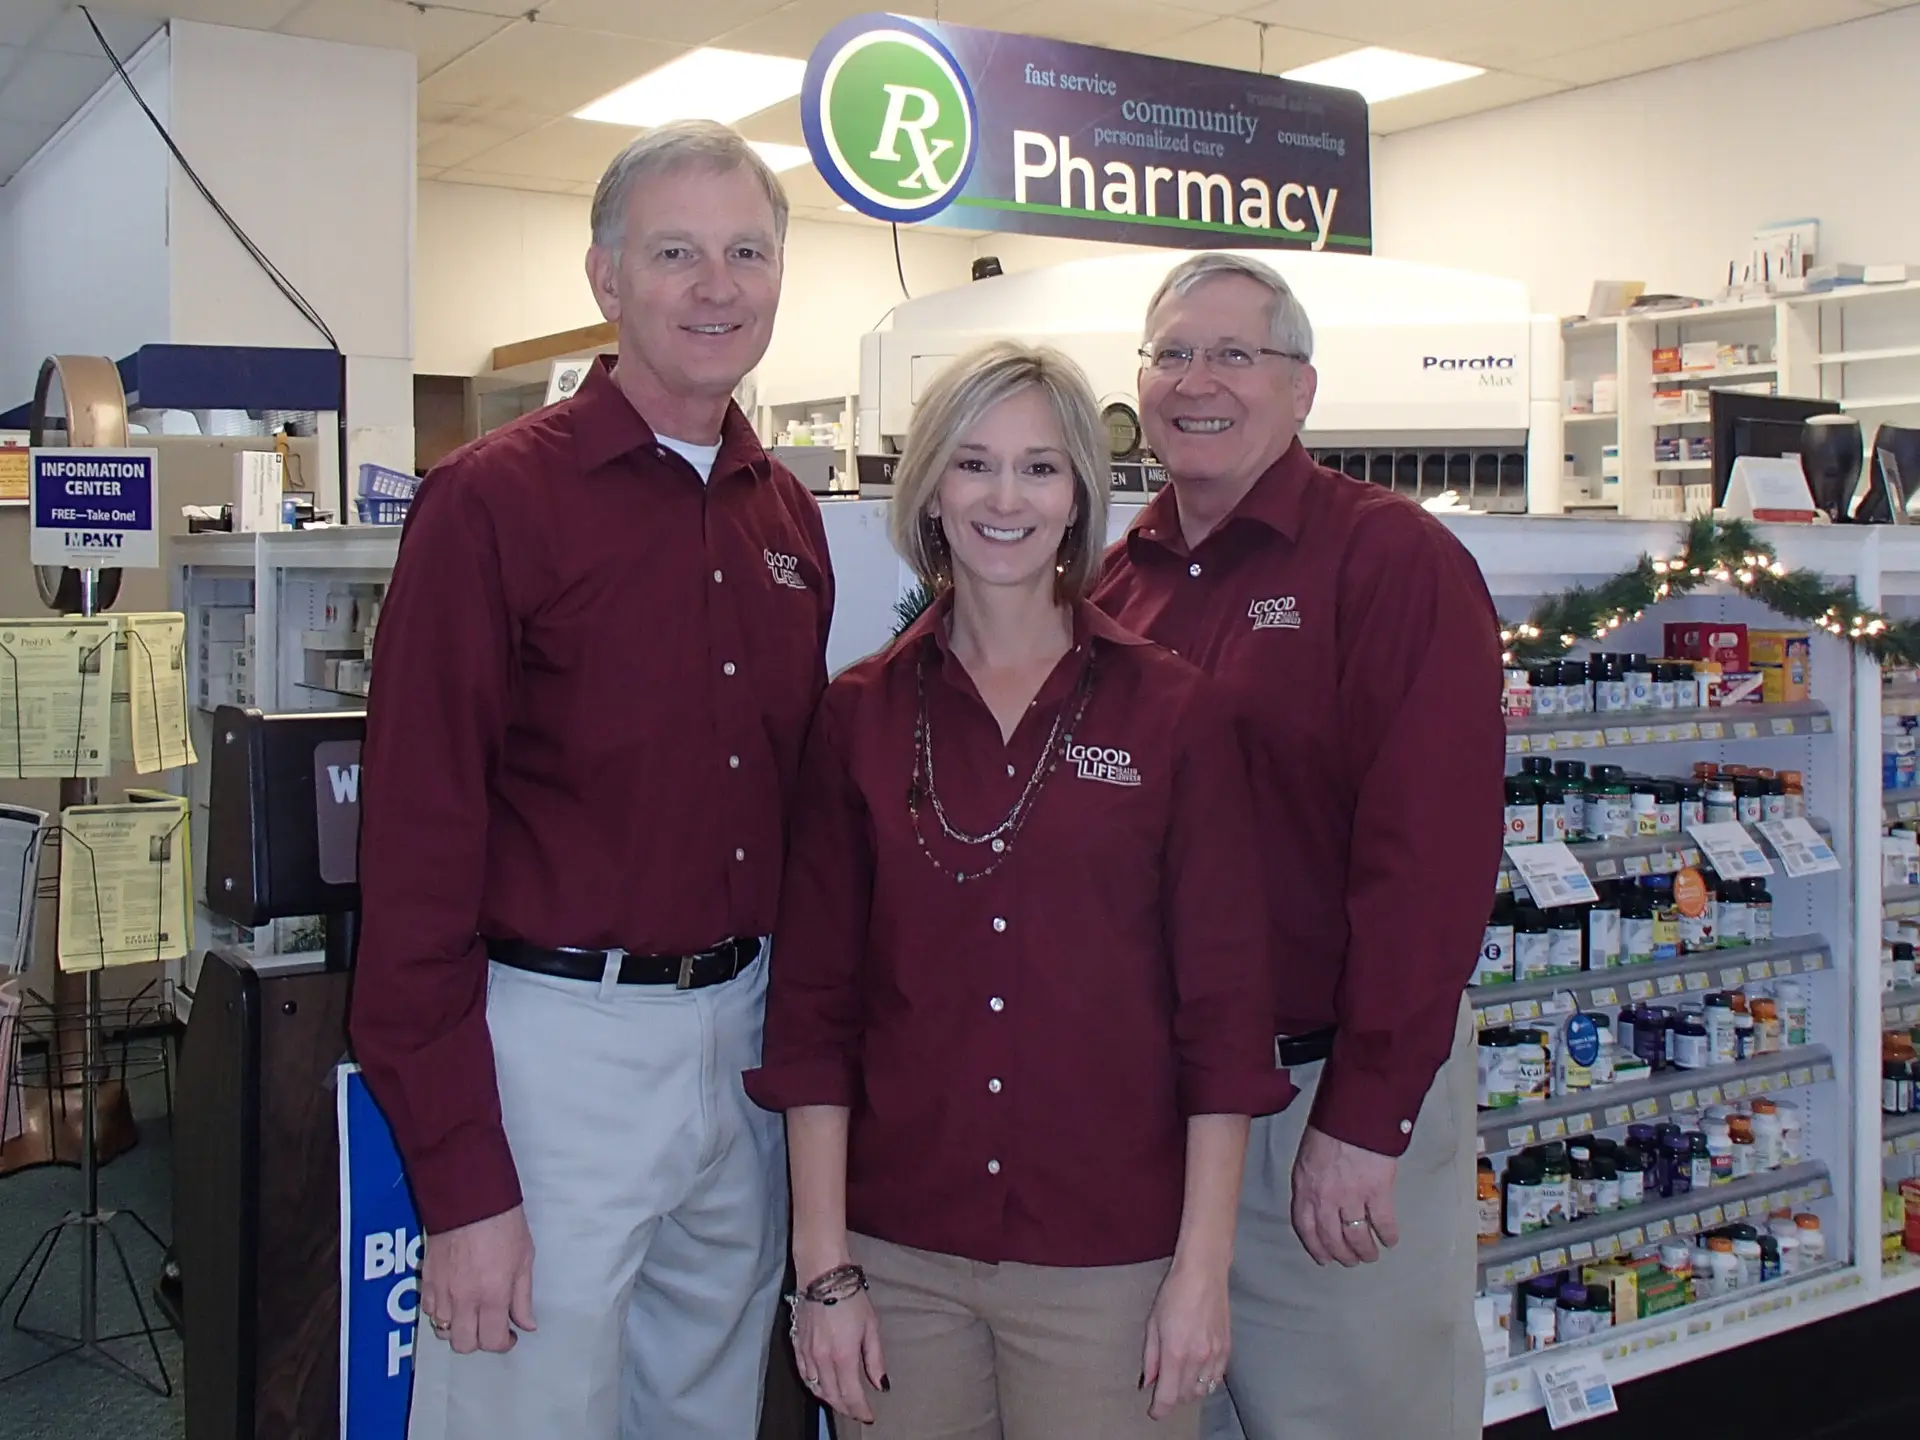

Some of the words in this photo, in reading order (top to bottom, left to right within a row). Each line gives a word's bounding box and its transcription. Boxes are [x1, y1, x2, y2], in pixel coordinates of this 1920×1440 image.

[1024, 63, 1056, 88] fast
[1060, 73, 1117, 96] service
[1122, 99, 1259, 144] community
[869, 83, 955, 191] Rx
[1094, 127, 1190, 154] personalized
[1193, 140, 1225, 158] care
[1277, 130, 1346, 157] counseling
[1013, 129, 1339, 252] Pharmacy
[1423, 355, 1513, 370] Parata
[41, 462, 145, 478] INFORMATION
[1111, 471, 1127, 486] EN
[65, 481, 121, 496] CENTER
[112, 510, 136, 522] One!
[766, 551, 798, 570] GOOD
[1254, 596, 1296, 614] GOOD
[1257, 611, 1283, 626] LIFE
[1071, 745, 1131, 766] GOOD
[1083, 760, 1116, 780] LIFE
[364, 1227, 424, 1280] Blo
